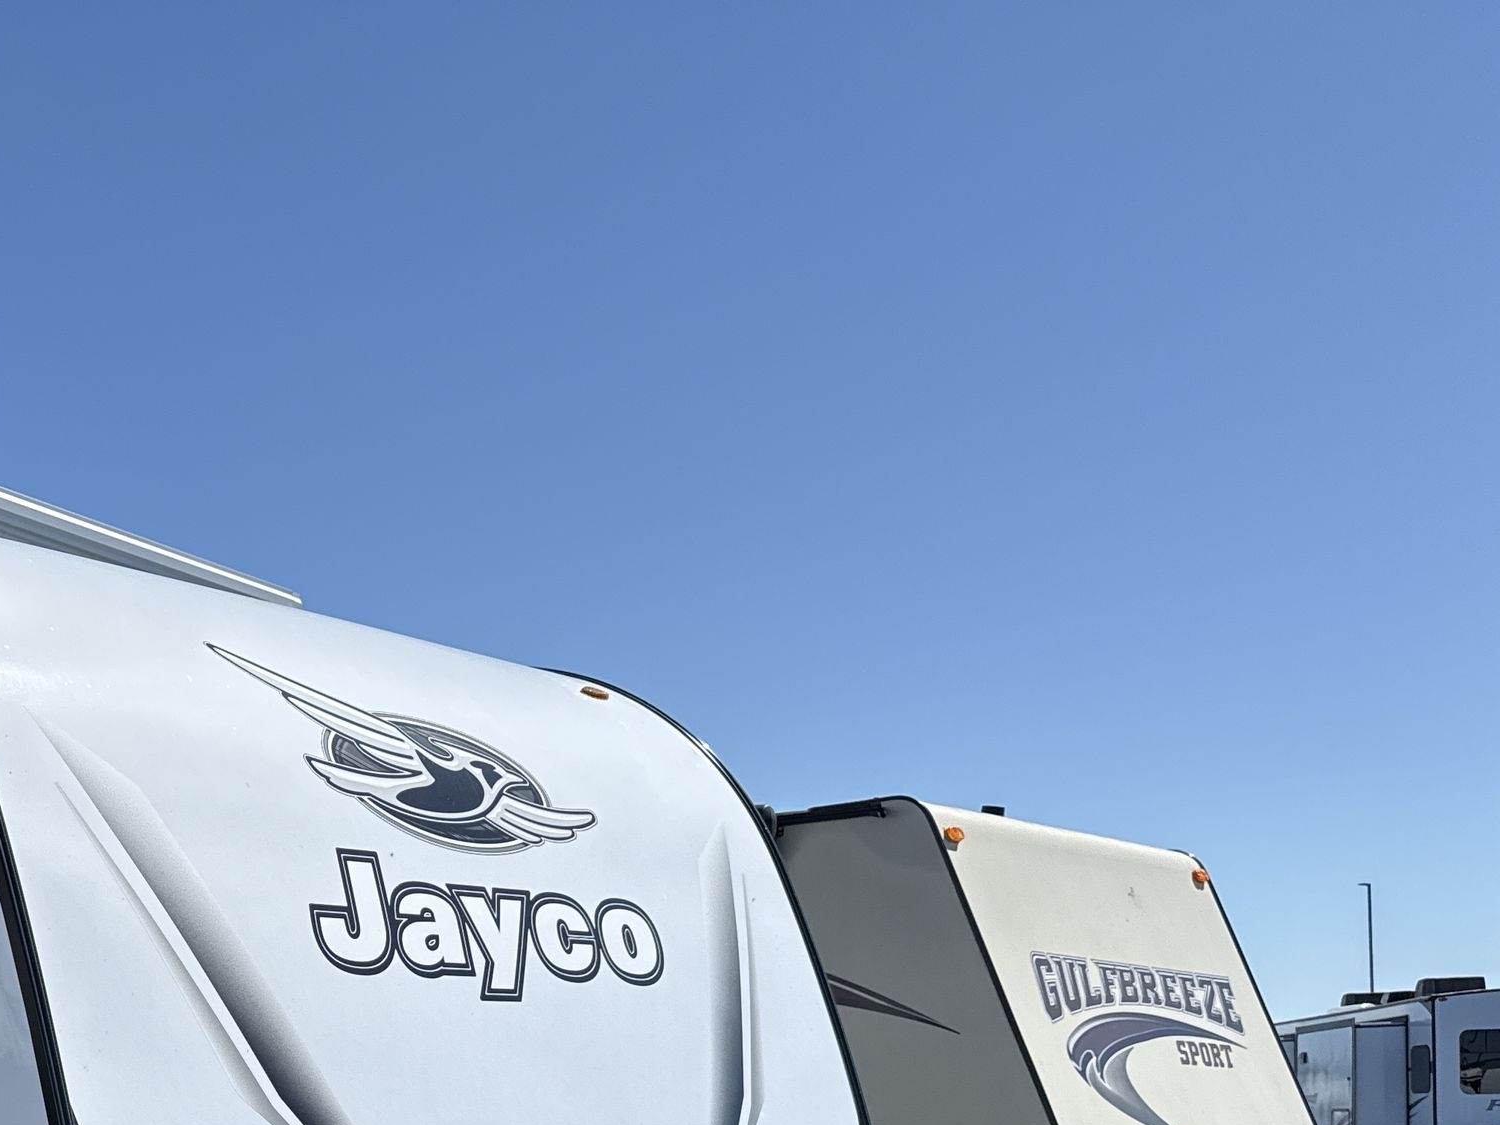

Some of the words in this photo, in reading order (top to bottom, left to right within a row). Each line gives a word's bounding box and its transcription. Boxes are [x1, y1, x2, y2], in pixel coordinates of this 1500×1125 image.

[309, 847, 665, 1002] Jayco
[1030, 950, 1245, 1036] GULFBREEZE
[1176, 1040, 1233, 1068] SPORT
